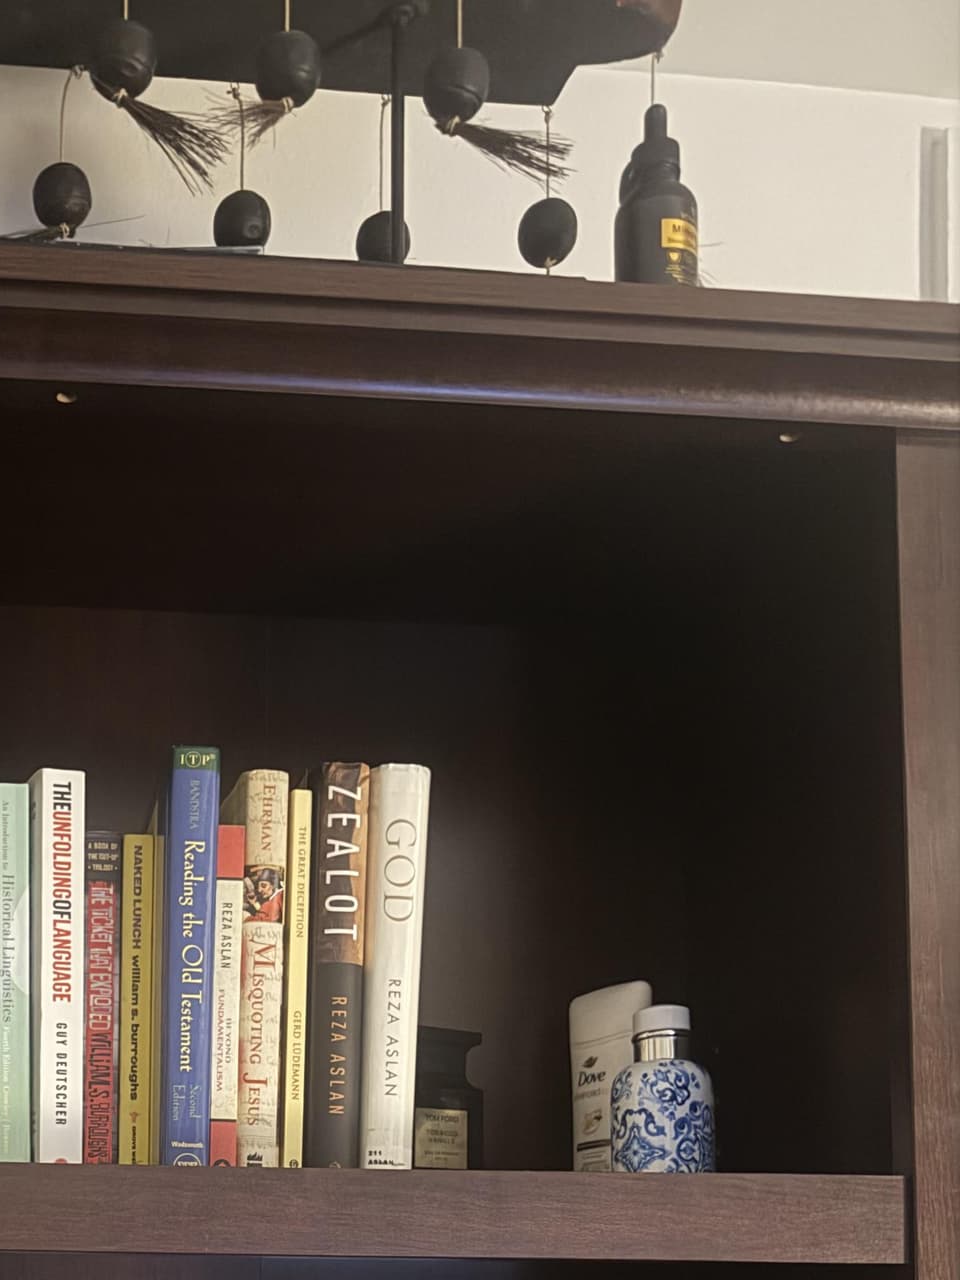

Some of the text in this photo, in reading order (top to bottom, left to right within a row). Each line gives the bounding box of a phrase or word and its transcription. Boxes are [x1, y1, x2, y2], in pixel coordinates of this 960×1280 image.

[261, 784, 277, 851] EHRMAN
[324, 785, 361, 941] ZEALOT
[132, 845, 143, 949] NAKED LUNCH
[383, 818, 417, 922] GOD
[179, 840, 206, 1072] Reading the Old Testament
[55, 1022, 68, 1126] GUY DEUTSCHER
[216, 989, 225, 1092] FUNDAMENTALISM
[328, 996, 348, 1115] REZA ASLAN
[578, 1070, 607, 1087] Dove
